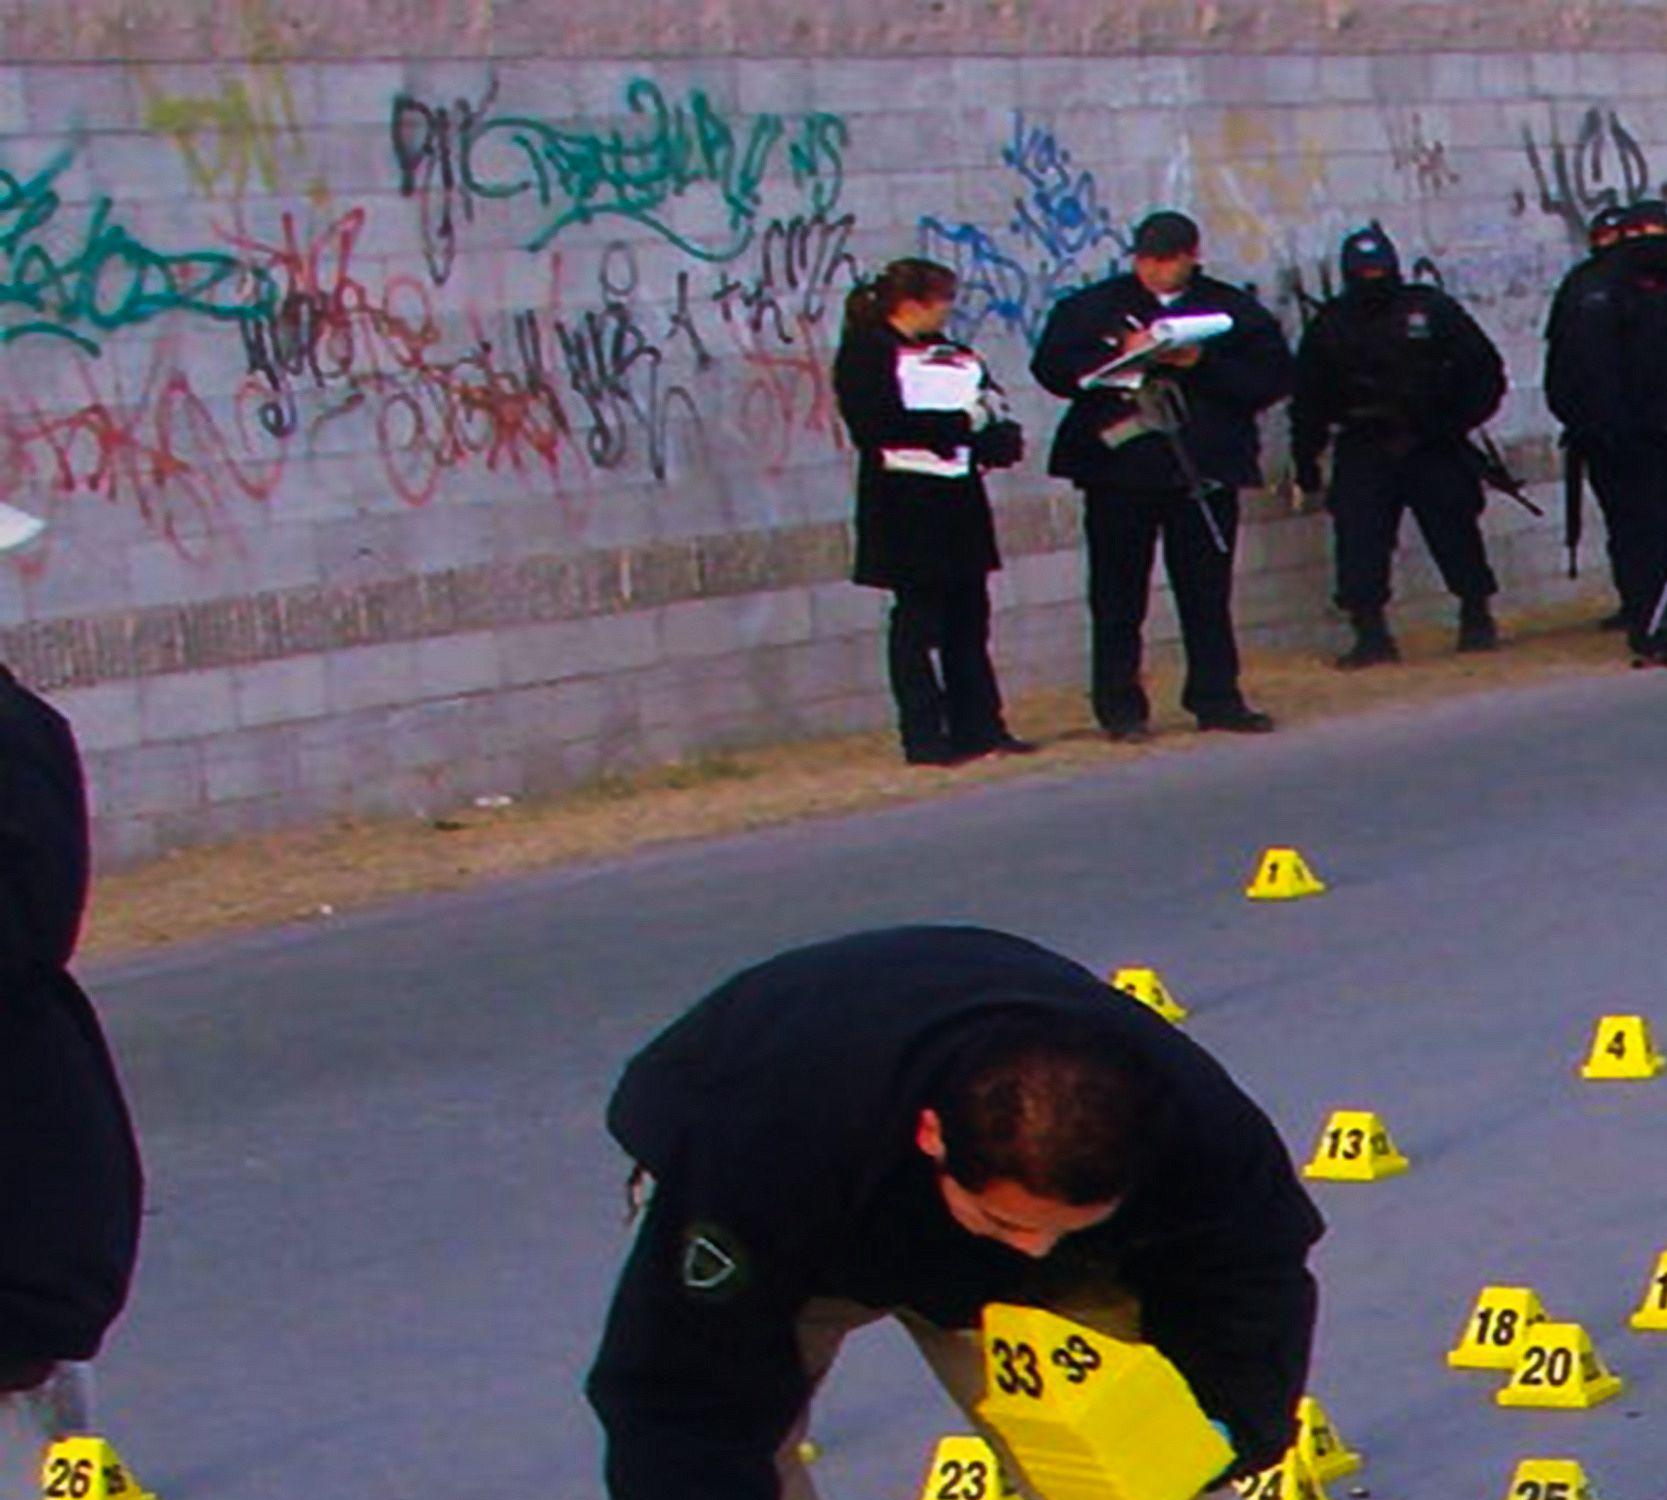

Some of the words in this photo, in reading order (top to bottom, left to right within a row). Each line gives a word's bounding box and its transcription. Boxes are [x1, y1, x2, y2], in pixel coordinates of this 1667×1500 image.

[1606, 1030, 1626, 1059] 4
[1320, 1124, 1365, 1161] 13
[1471, 1302, 1519, 1347] 18
[985, 1336, 1045, 1401] 33
[1050, 1328, 1106, 1385] 33
[1518, 1345, 1573, 1388] 20
[41, 1451, 93, 1500] 26
